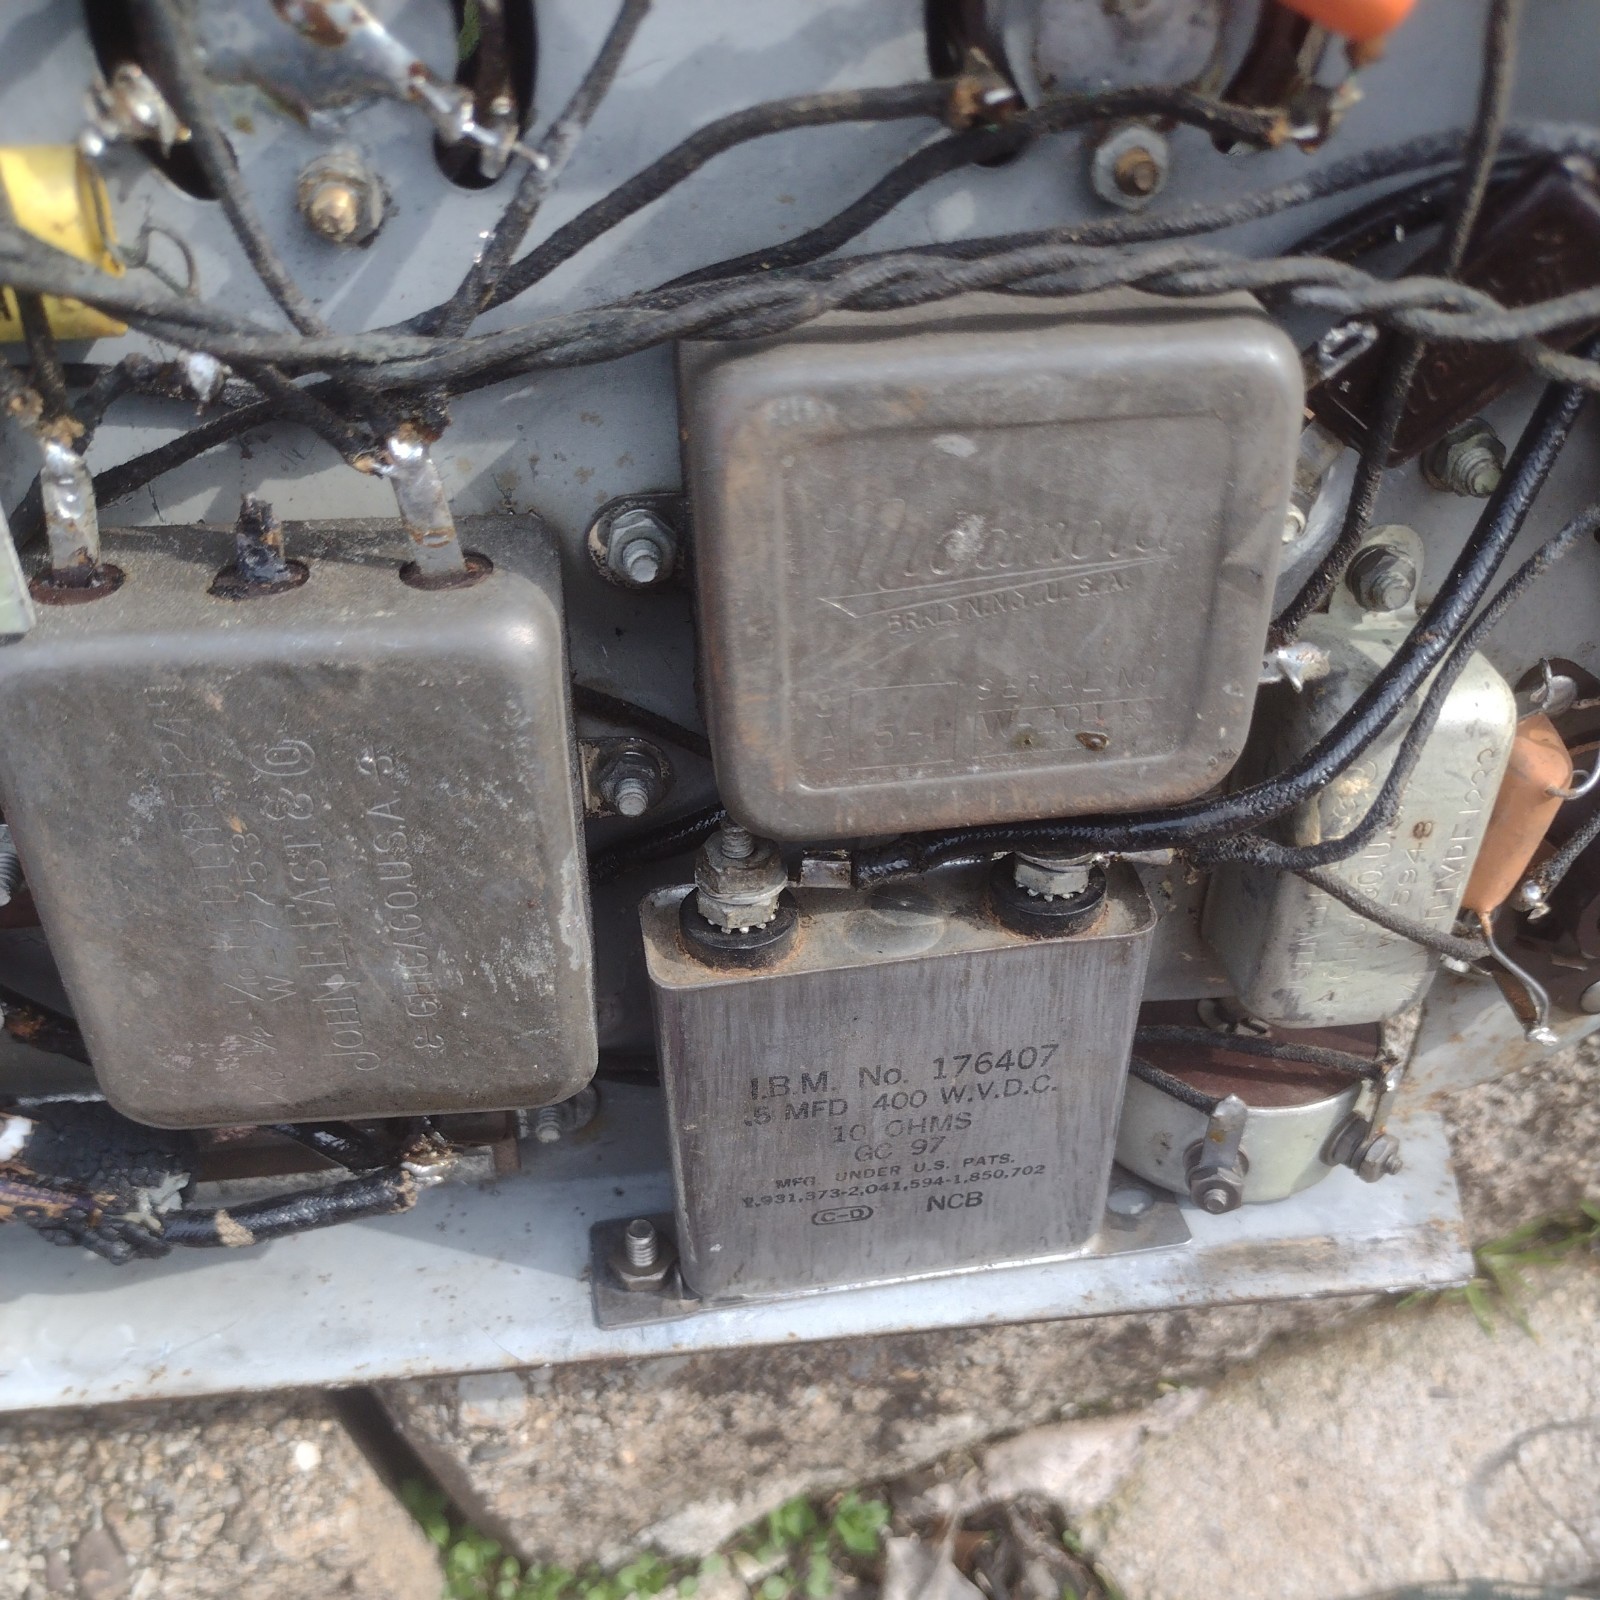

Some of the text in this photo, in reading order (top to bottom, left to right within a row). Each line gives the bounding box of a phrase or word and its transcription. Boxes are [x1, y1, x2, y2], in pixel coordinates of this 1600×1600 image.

[310, 974, 382, 1072] JOHN
[750, 1043, 1060, 1101] I.B.M. No. 176407
[743, 1074, 1058, 1127] .5 MFD 400 W.V.D.C.
[832, 1111, 973, 1143] 10 OHMS
[854, 1136, 947, 1162] GC 97
[835, 1165, 901, 1182] UNDER
[913, 1160, 950, 1173] U.S.
[962, 1153, 1016, 1168] PATS.
[926, 1191, 984, 1213] NCB
